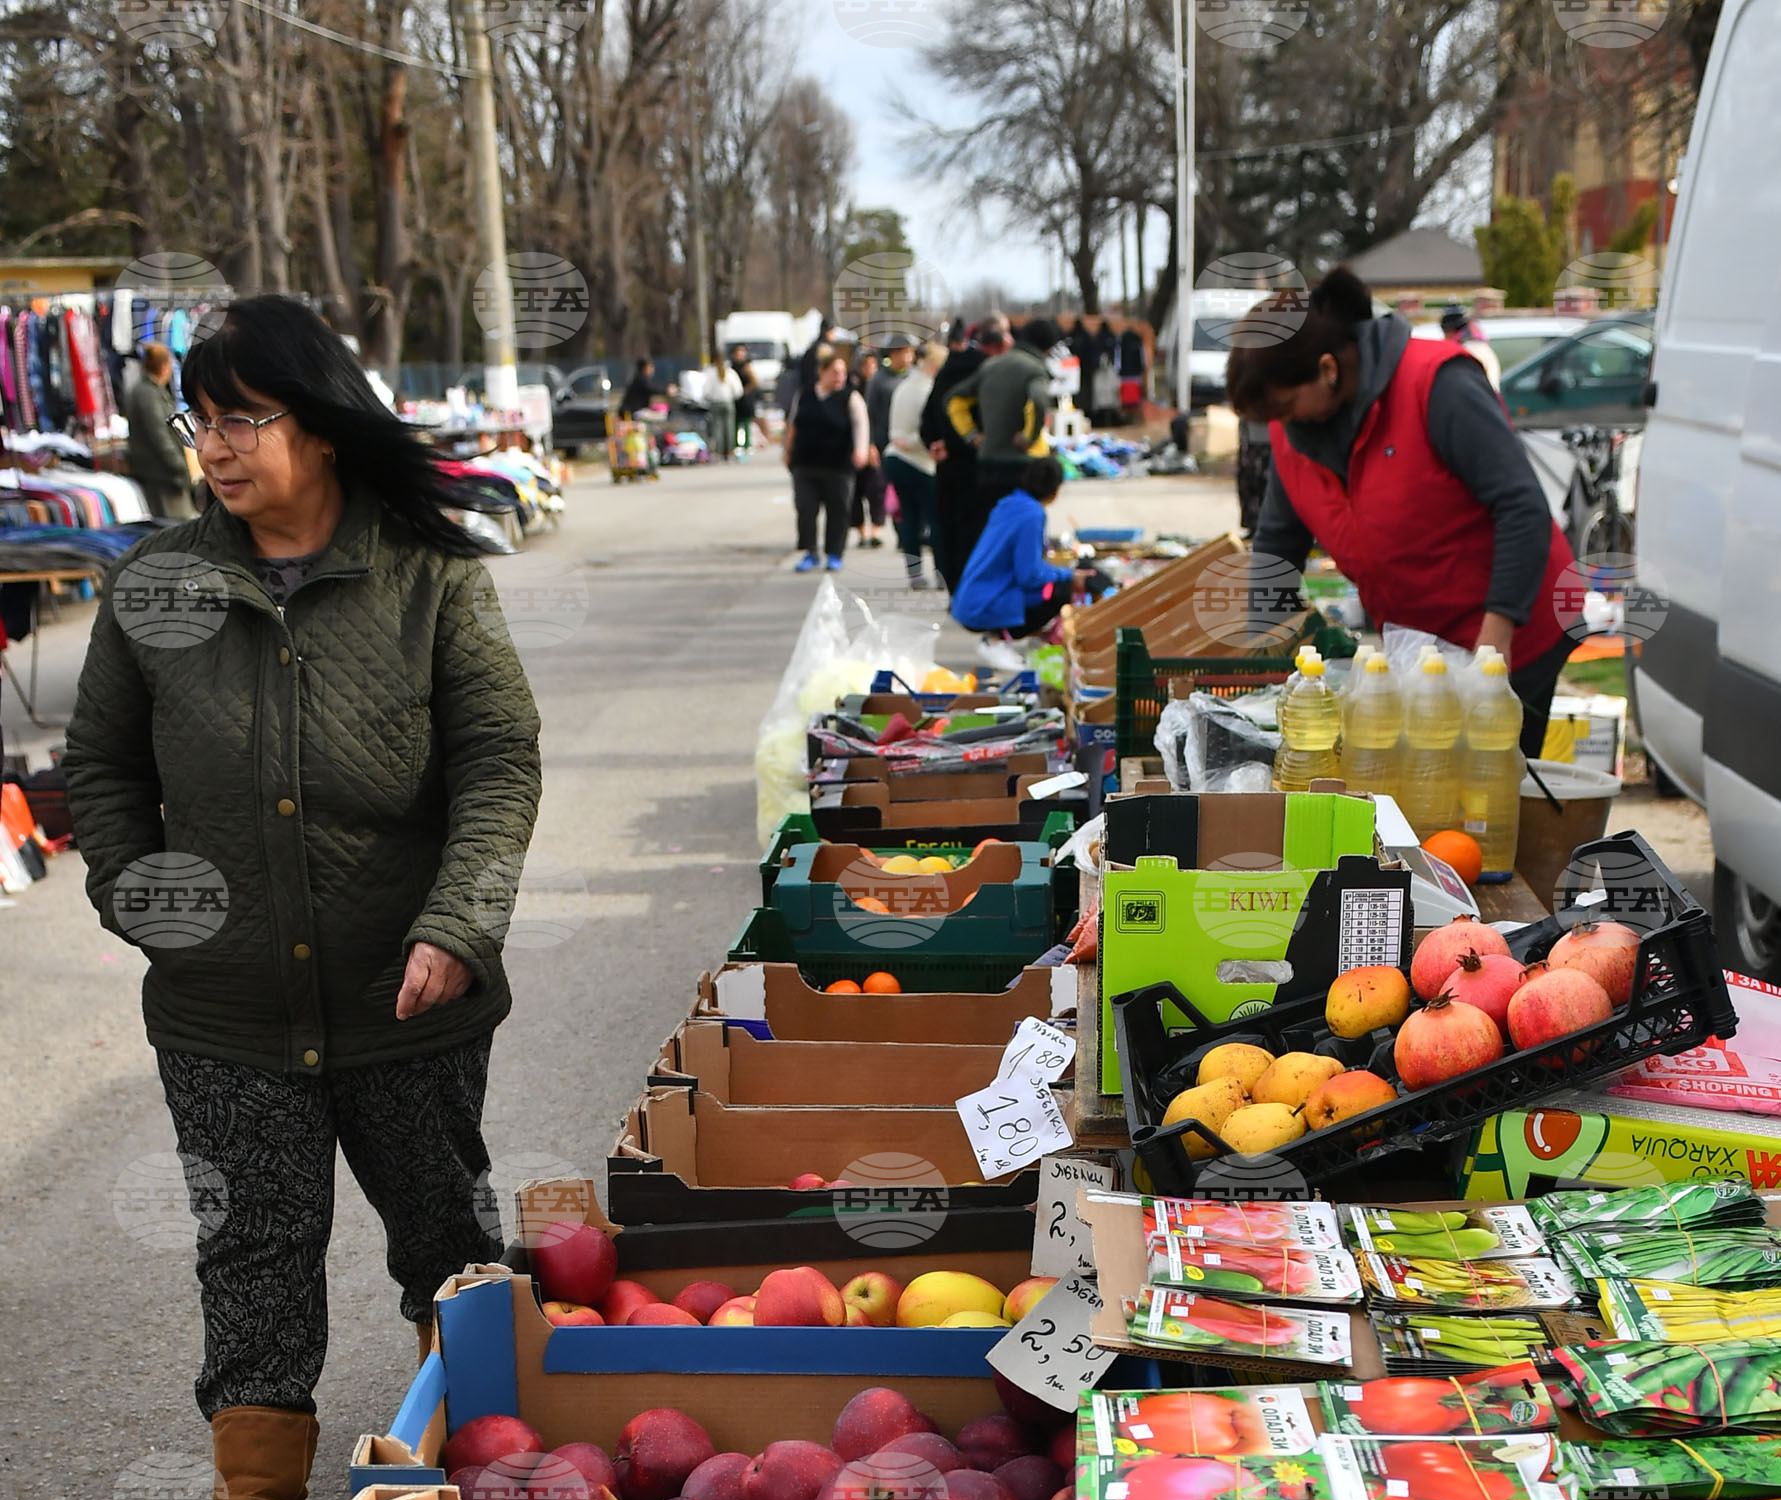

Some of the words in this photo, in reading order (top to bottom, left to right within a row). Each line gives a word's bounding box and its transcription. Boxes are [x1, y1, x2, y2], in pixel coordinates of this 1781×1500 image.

[1228, 890, 1290, 912] KIWI
[1738, 974, 1762, 990] ЗА
[1676, 1057, 1716, 1070] kg
[1631, 1134, 1739, 1167] XARQUÍA
